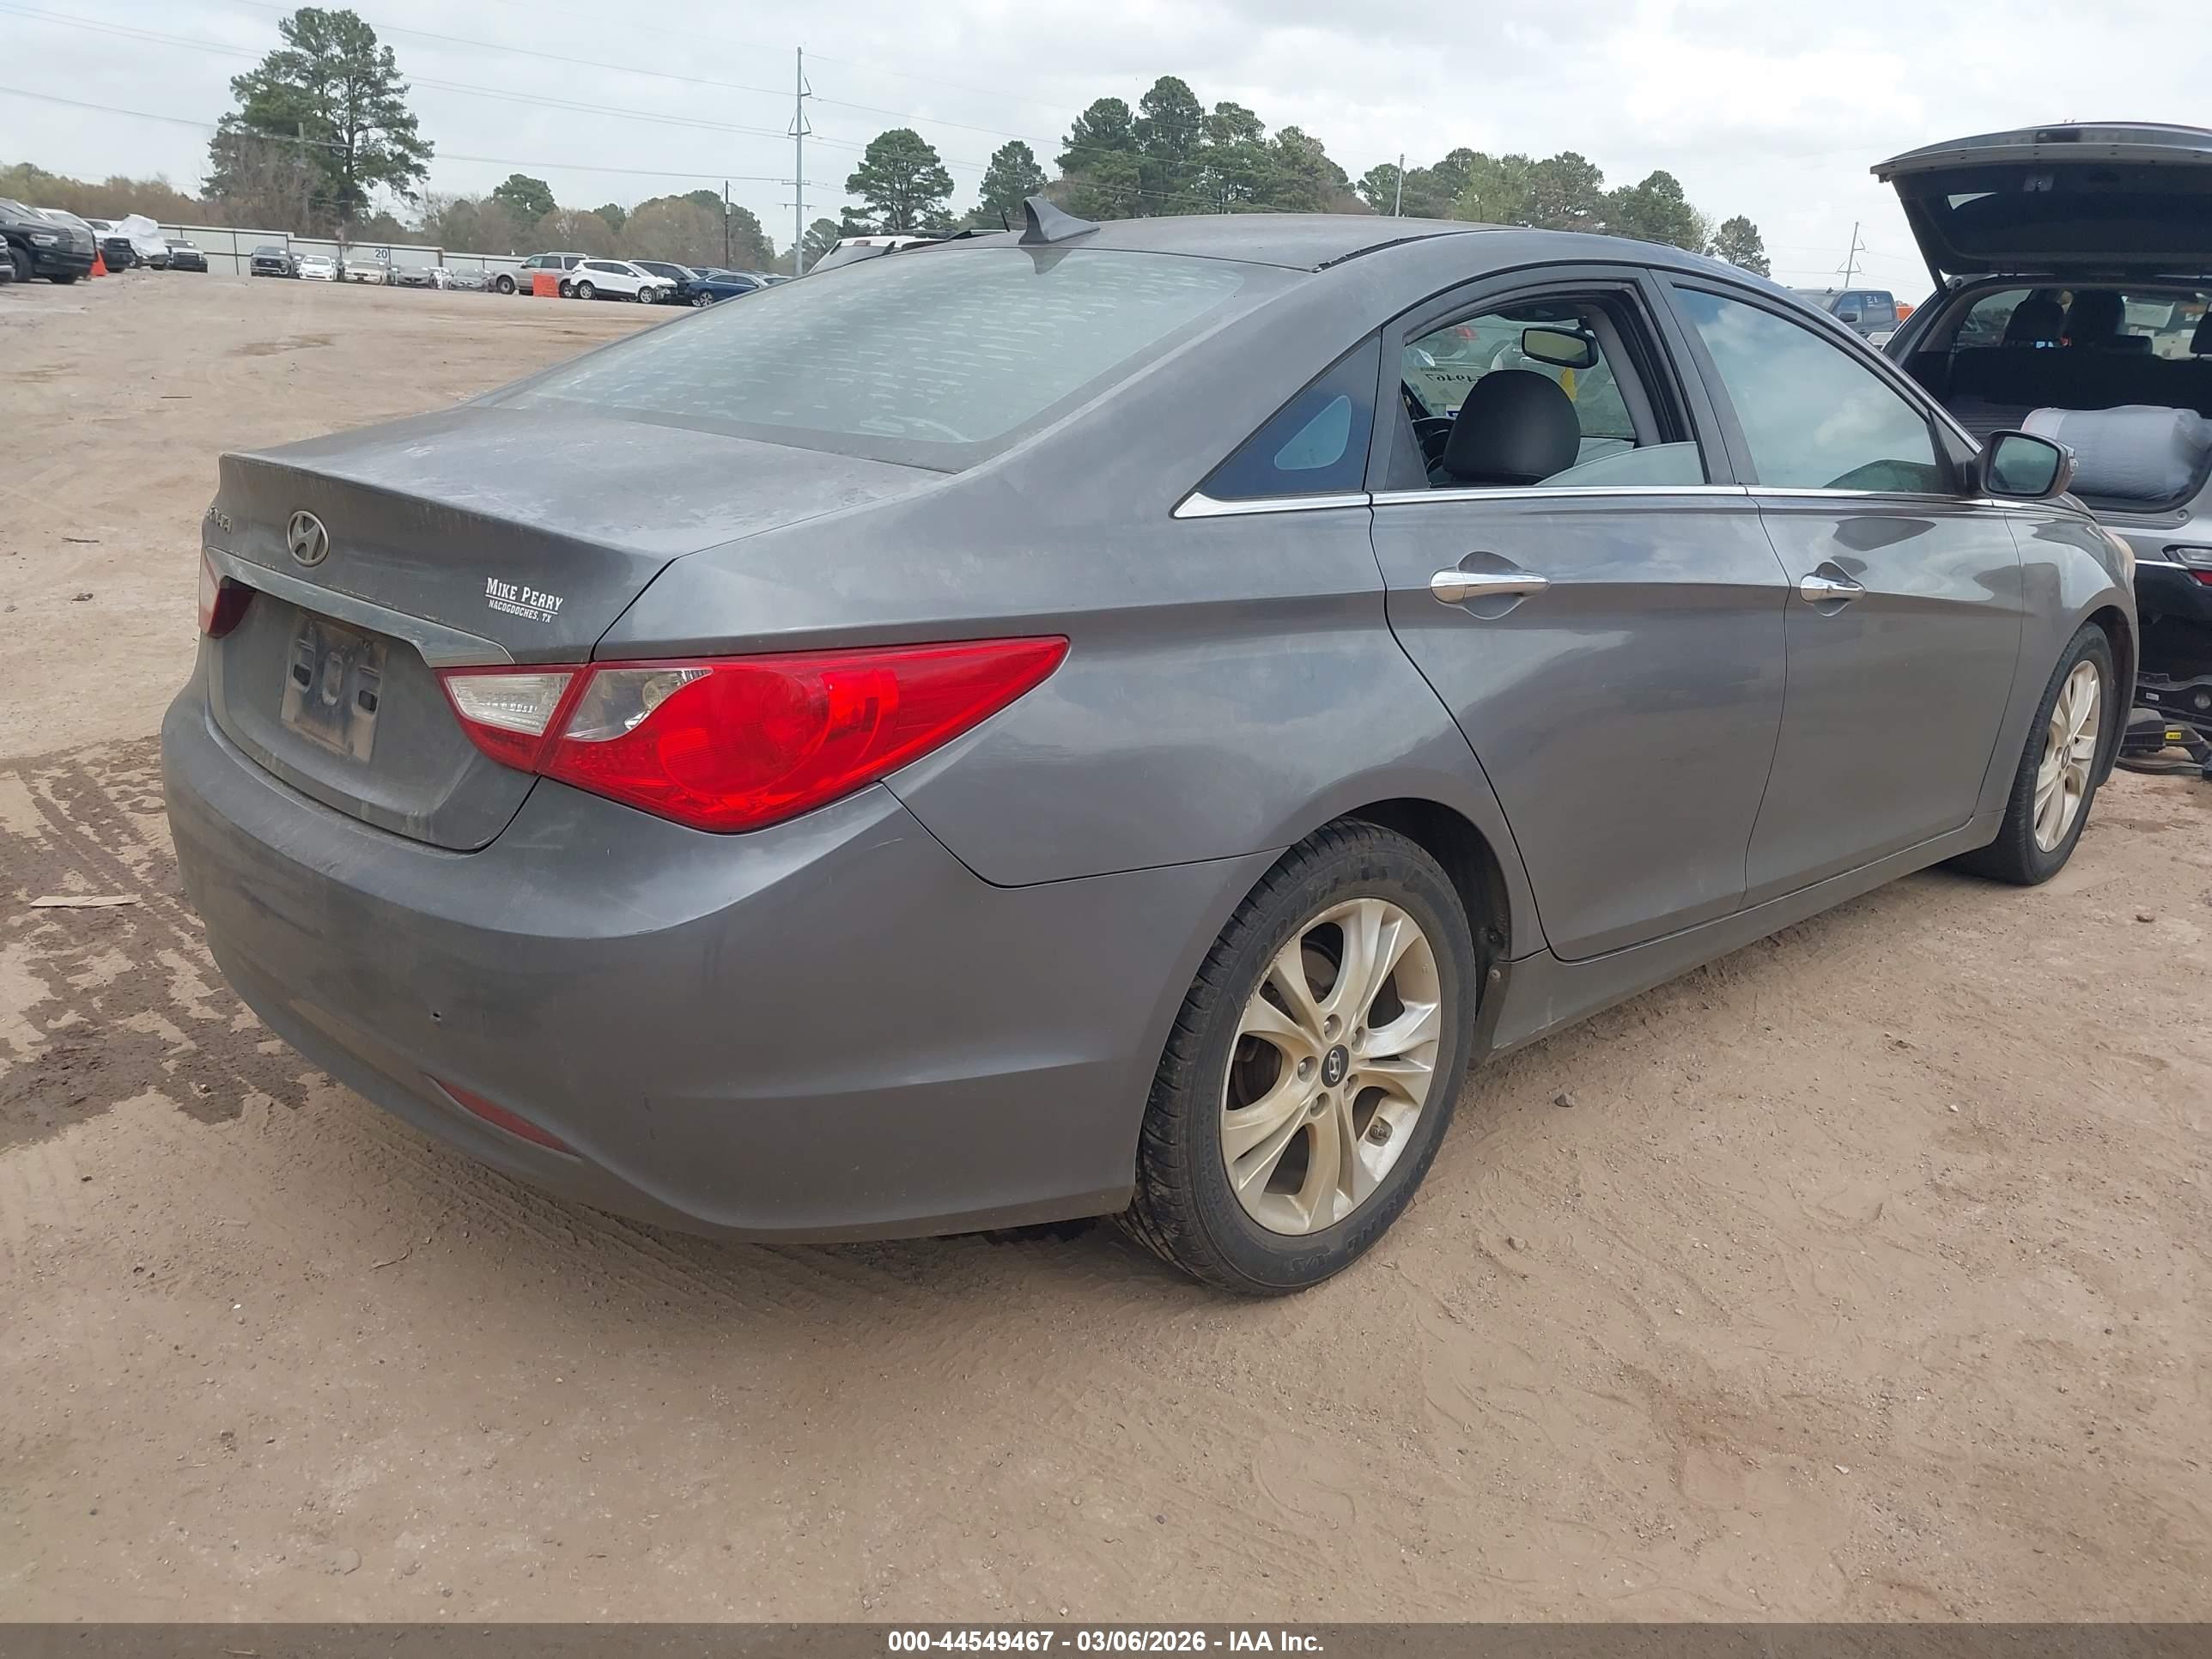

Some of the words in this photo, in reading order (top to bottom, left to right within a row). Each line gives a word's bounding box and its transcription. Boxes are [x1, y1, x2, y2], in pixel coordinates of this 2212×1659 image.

[374, 249, 388, 258] 20
[486, 577, 518, 601] MIKE
[520, 586, 563, 611] PERRY
[488, 599, 539, 622] NACOGDOCHES,
[542, 612, 552, 623] TX
